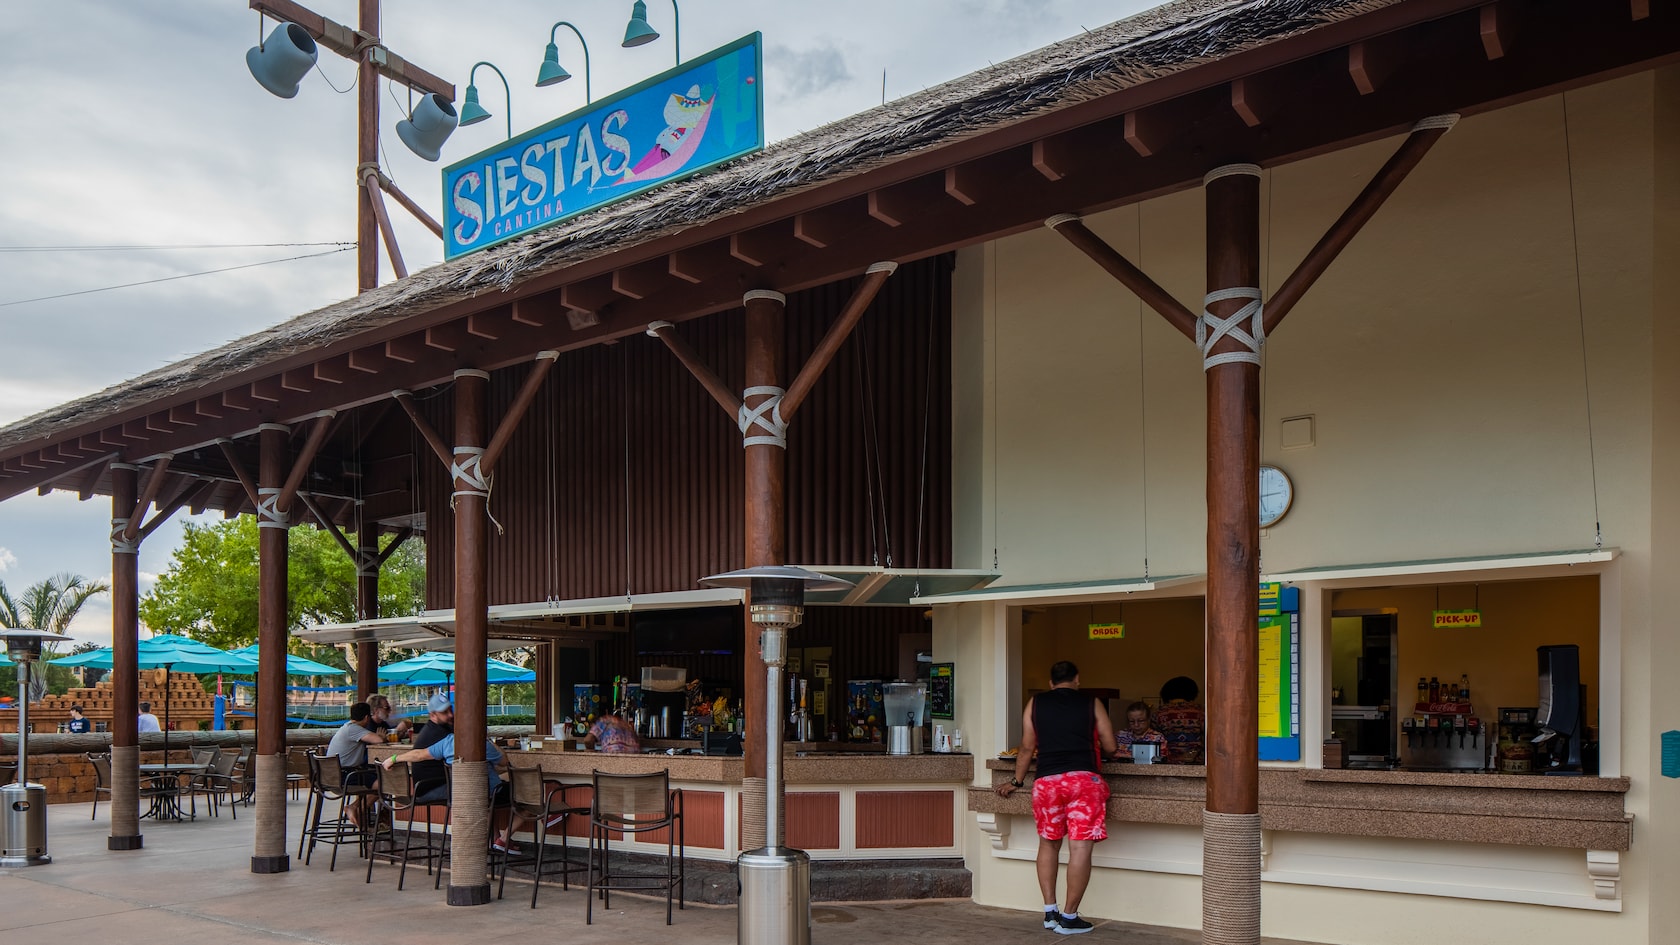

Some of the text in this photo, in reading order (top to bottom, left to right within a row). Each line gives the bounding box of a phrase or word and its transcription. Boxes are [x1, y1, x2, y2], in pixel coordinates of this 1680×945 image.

[453, 109, 632, 246] SIESTAS
[493, 199, 564, 236] CANTINA
[1436, 614, 1478, 624] PICK-UP
[1092, 627, 1120, 636] ORDER
